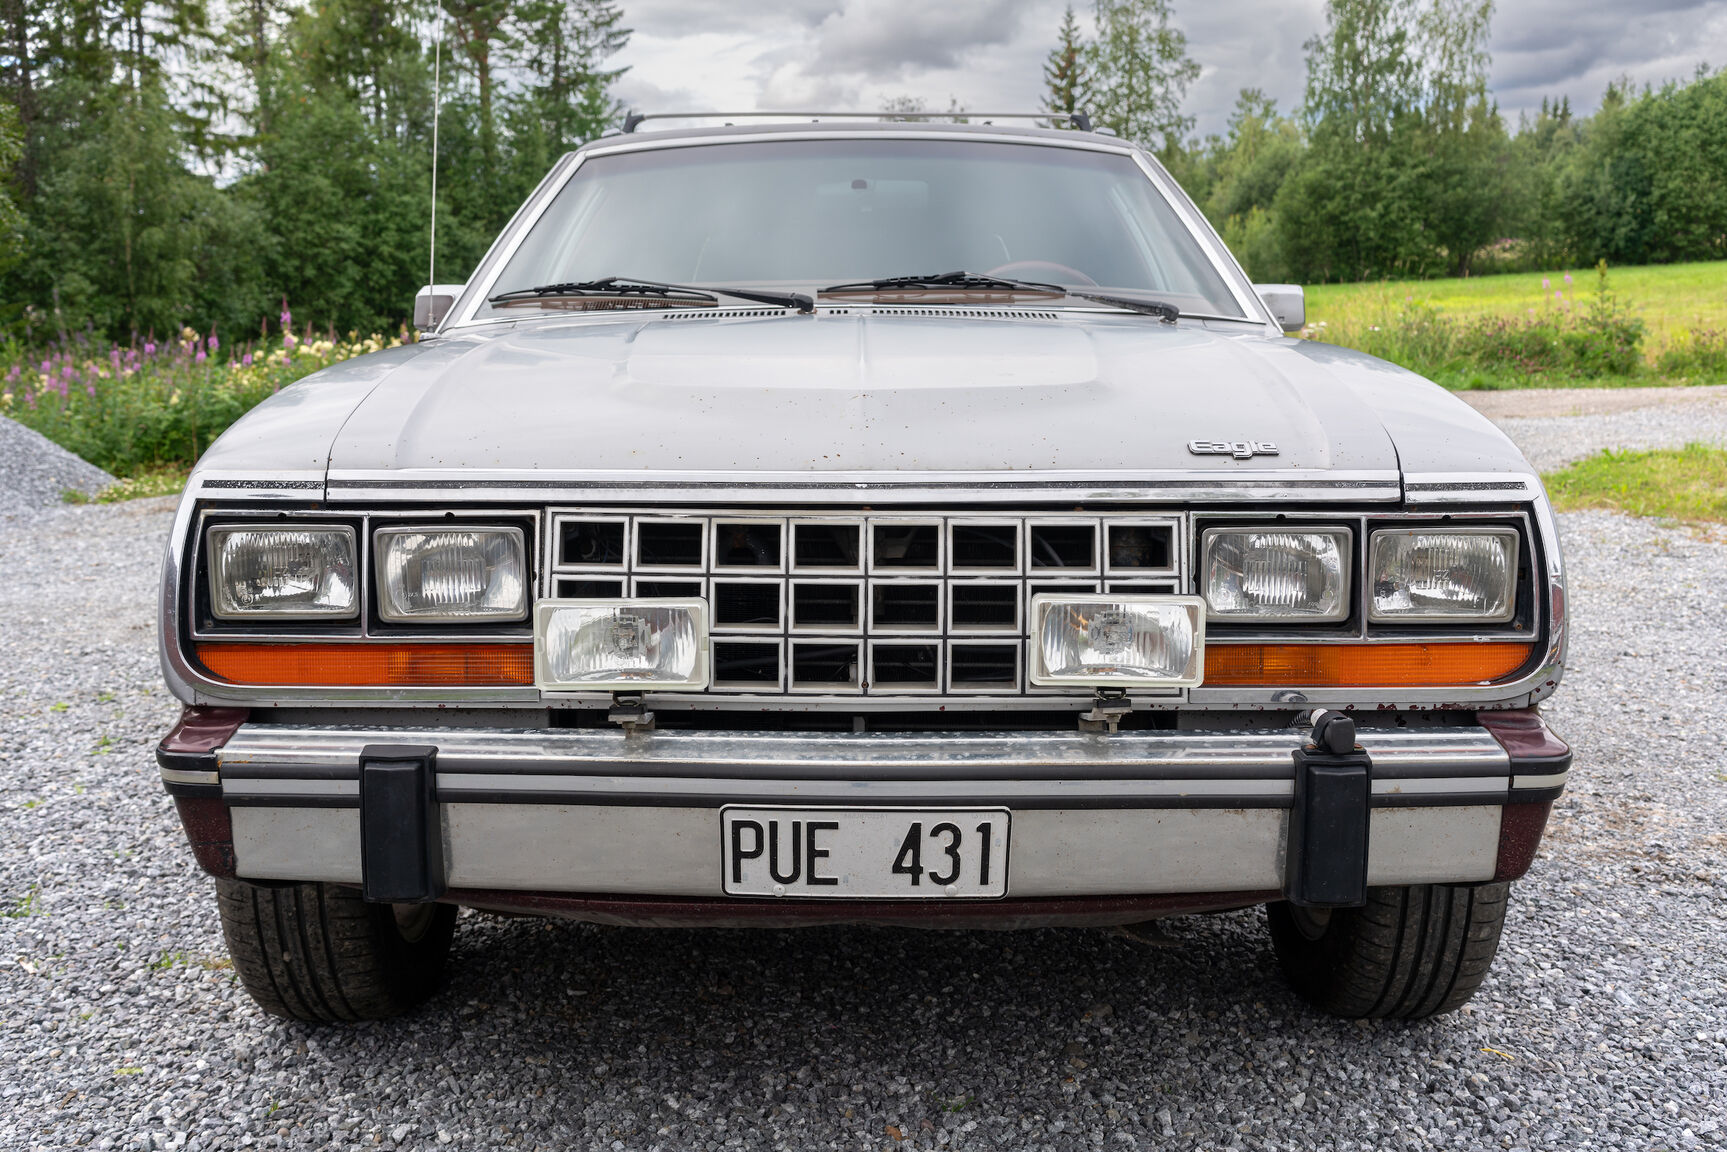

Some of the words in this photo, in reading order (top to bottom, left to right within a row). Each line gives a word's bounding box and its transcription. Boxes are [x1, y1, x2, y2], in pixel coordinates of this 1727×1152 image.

[1187, 440, 1279, 460] Eagle
[731, 819, 839, 885] PUE
[891, 821, 992, 886] 431
